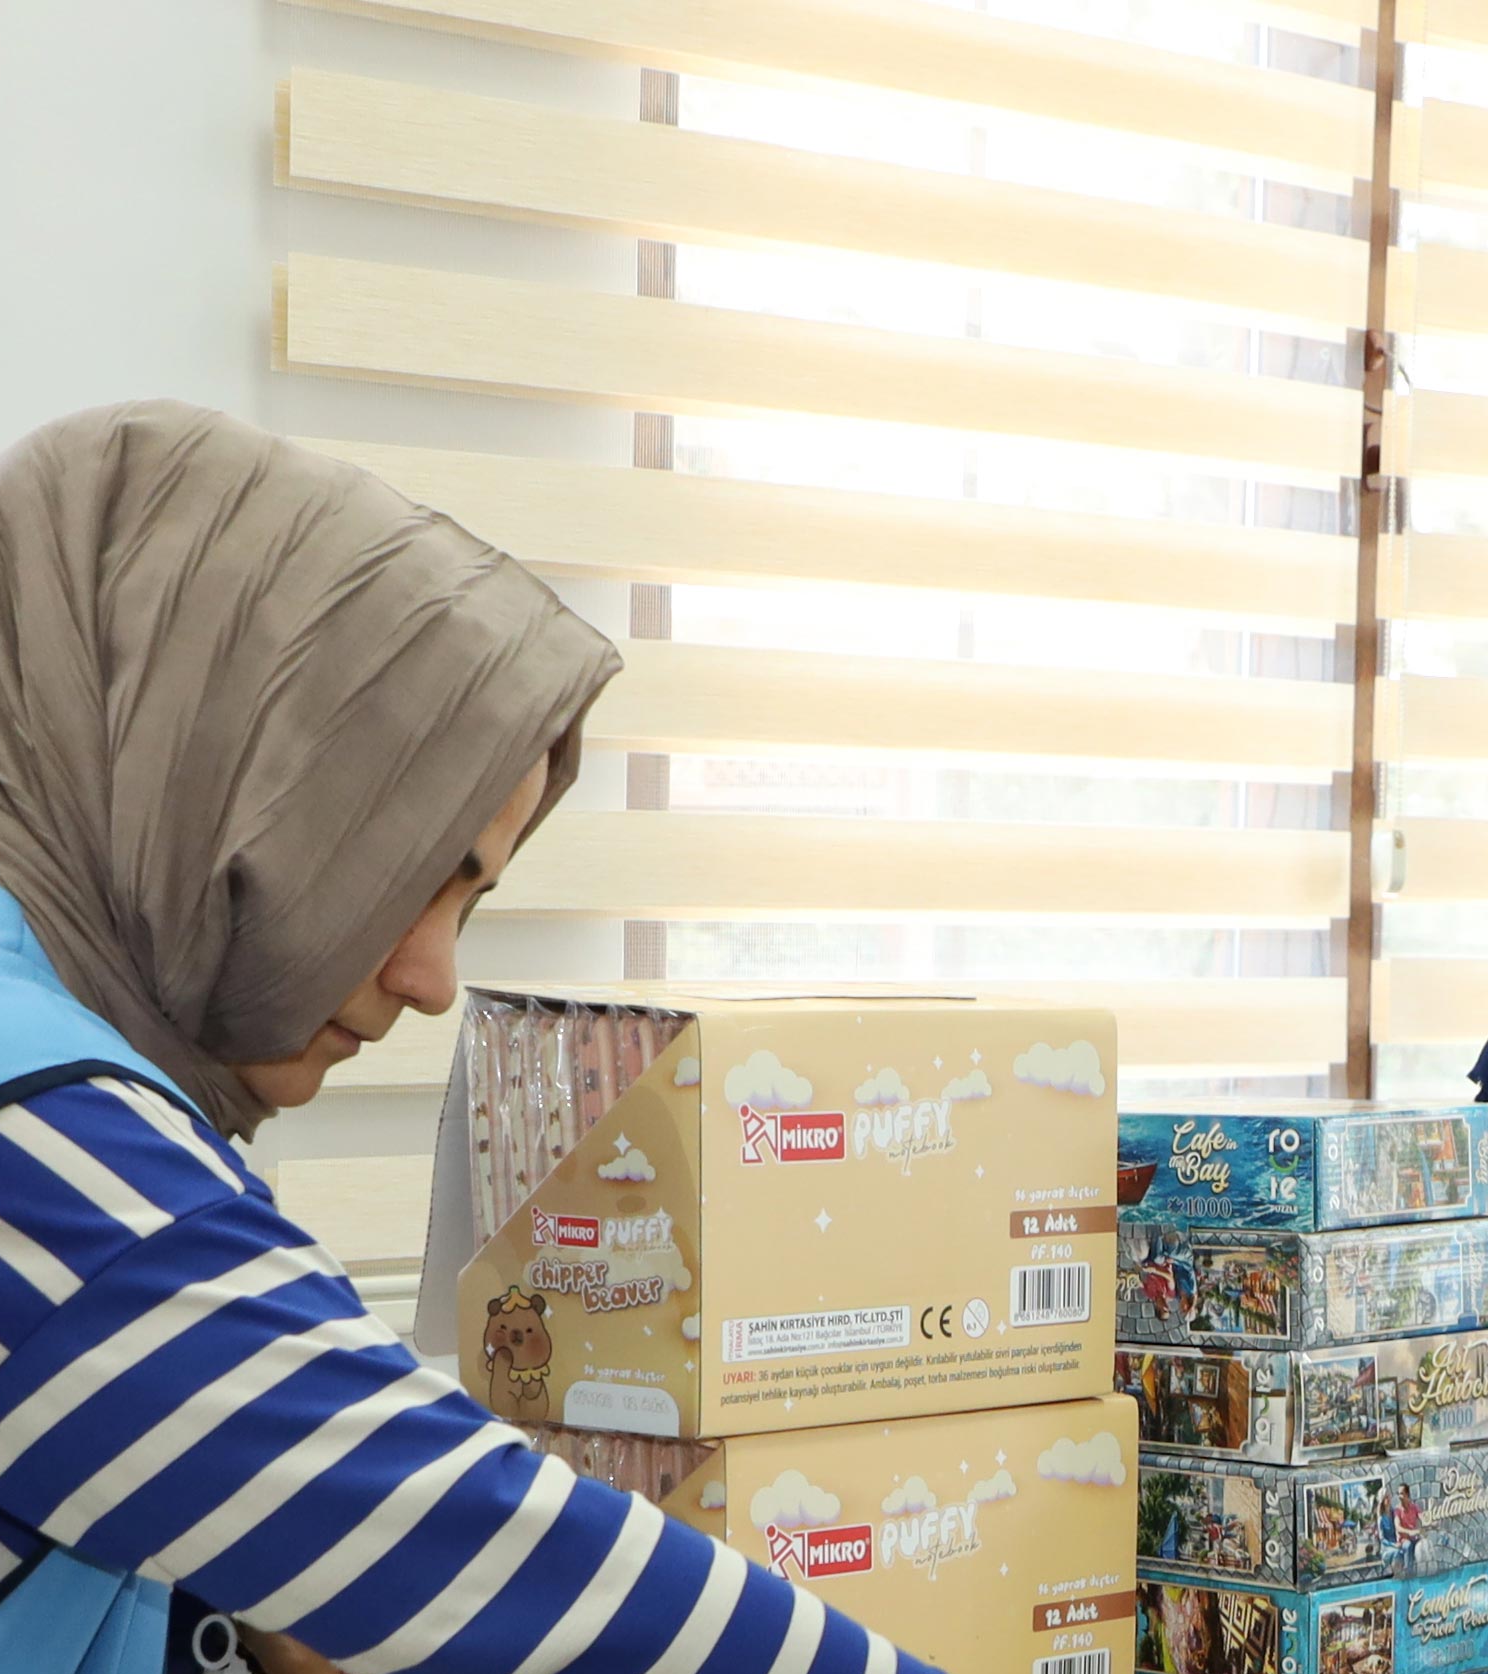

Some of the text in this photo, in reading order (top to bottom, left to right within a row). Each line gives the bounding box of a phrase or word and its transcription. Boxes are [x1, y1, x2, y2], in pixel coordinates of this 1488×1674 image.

[781, 1100, 952, 1157] MİKRO PUFFY
[1173, 1120, 1226, 1157] Cafe
[1179, 1155, 1231, 1193] Bay
[605, 1217, 672, 1245] PUFFY
[530, 1259, 608, 1293] chipper
[582, 1277, 662, 1312] beaver
[748, 1318, 776, 1335] ŞAHİN
[780, 1314, 825, 1330] KIRTASİYE
[810, 1501, 977, 1566] MİKRO PUFFY
[1407, 1574, 1488, 1624] Comfort
